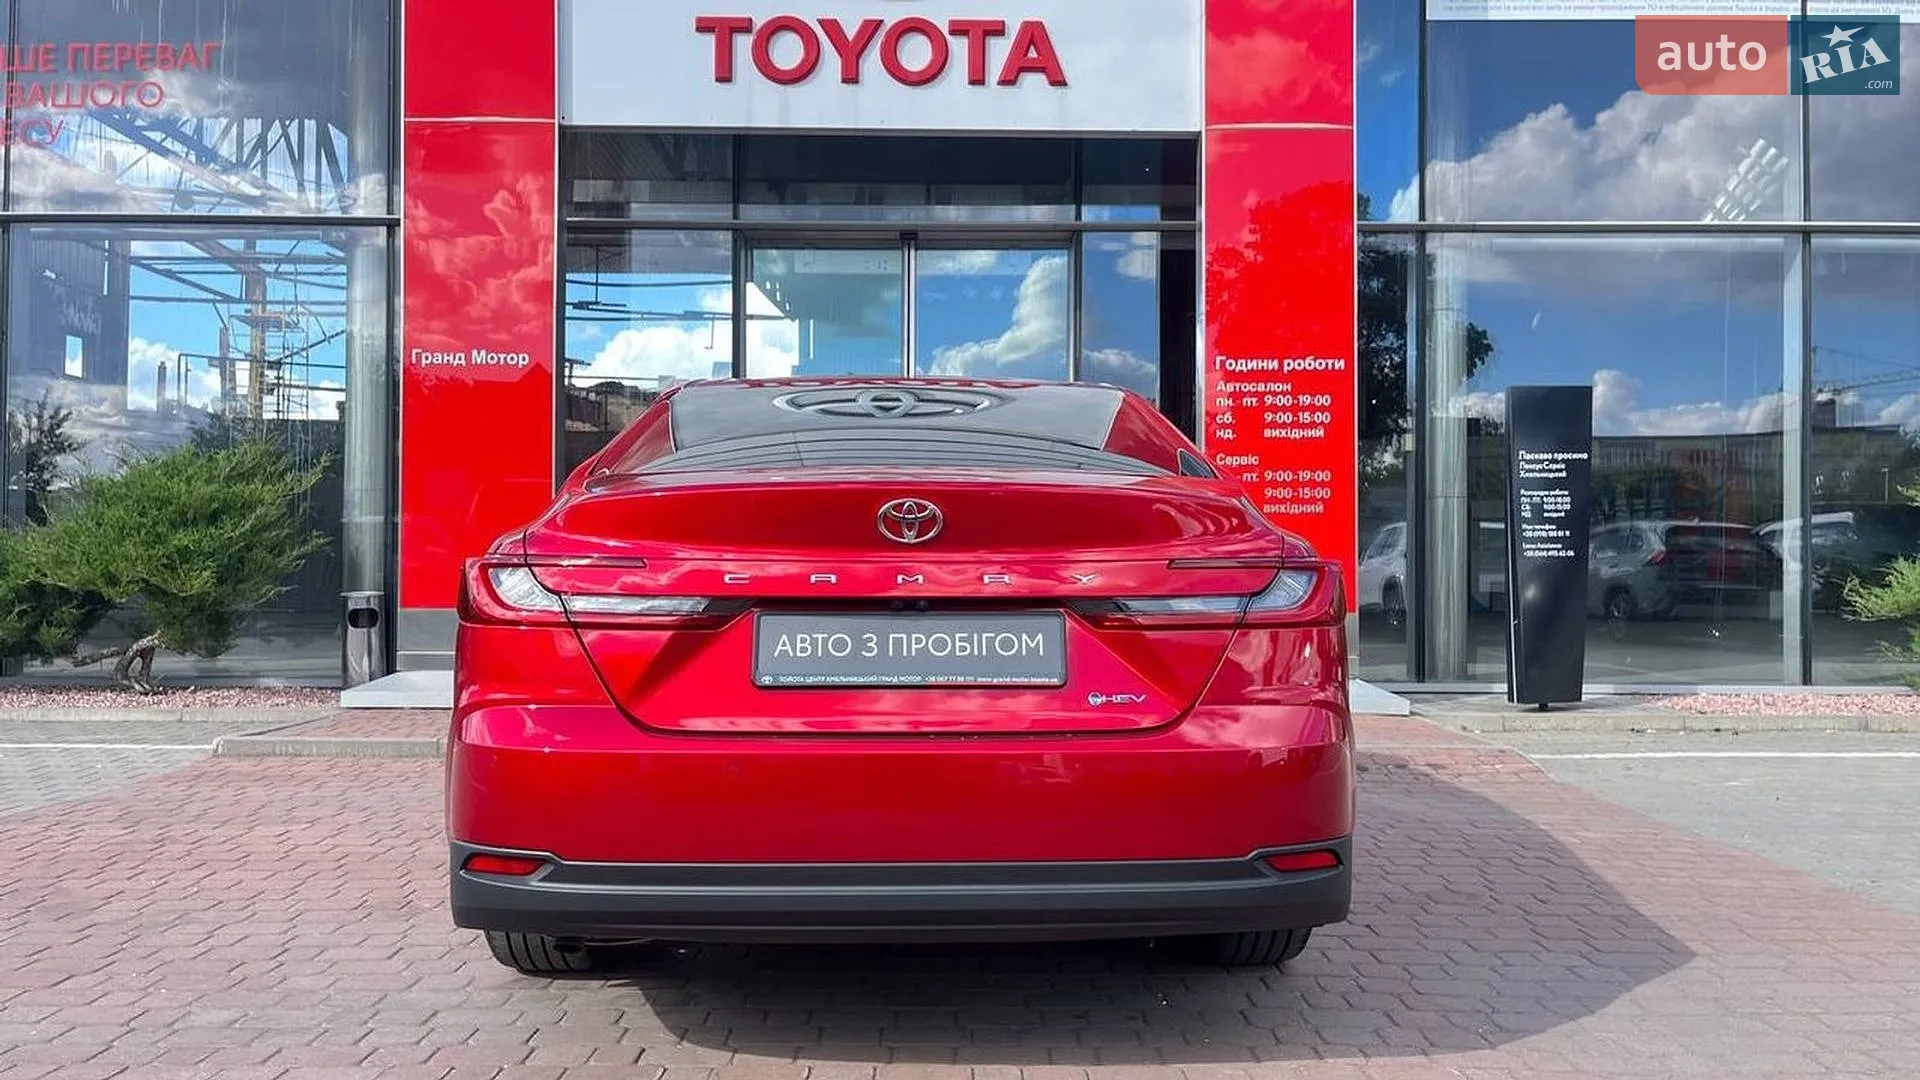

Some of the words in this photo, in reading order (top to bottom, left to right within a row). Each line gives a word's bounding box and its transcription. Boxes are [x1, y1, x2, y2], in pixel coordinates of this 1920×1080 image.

[68, 41, 220, 72] ПЕРЕВАГ
[694, 15, 1068, 87] TOYOTA
[5, 79, 165, 109] ВАШОГО
[411, 348, 466, 368] Гранд
[471, 349, 530, 368] Мотор
[1215, 355, 1279, 373] Години
[1283, 355, 1346, 374] роботи
[1216, 381, 1292, 393] Автосалон
[1263, 394, 1332, 407] 9:00-19:00
[1263, 411, 1332, 424] 9:00-15:00
[1263, 426, 1325, 440] вихідний
[1216, 452, 1260, 467] Сервіс
[1263, 470, 1332, 482] 9:00-19:00
[1263, 486, 1332, 500] 9:00-15:00
[1262, 501, 1325, 515] вихідний
[723, 574, 1097, 586] CAMRY
[774, 633, 851, 657] АВТО
[861, 633, 878, 657] З
[889, 632, 1044, 657] ПРОБІГОМ
[1102, 694, 1147, 704] HEV
